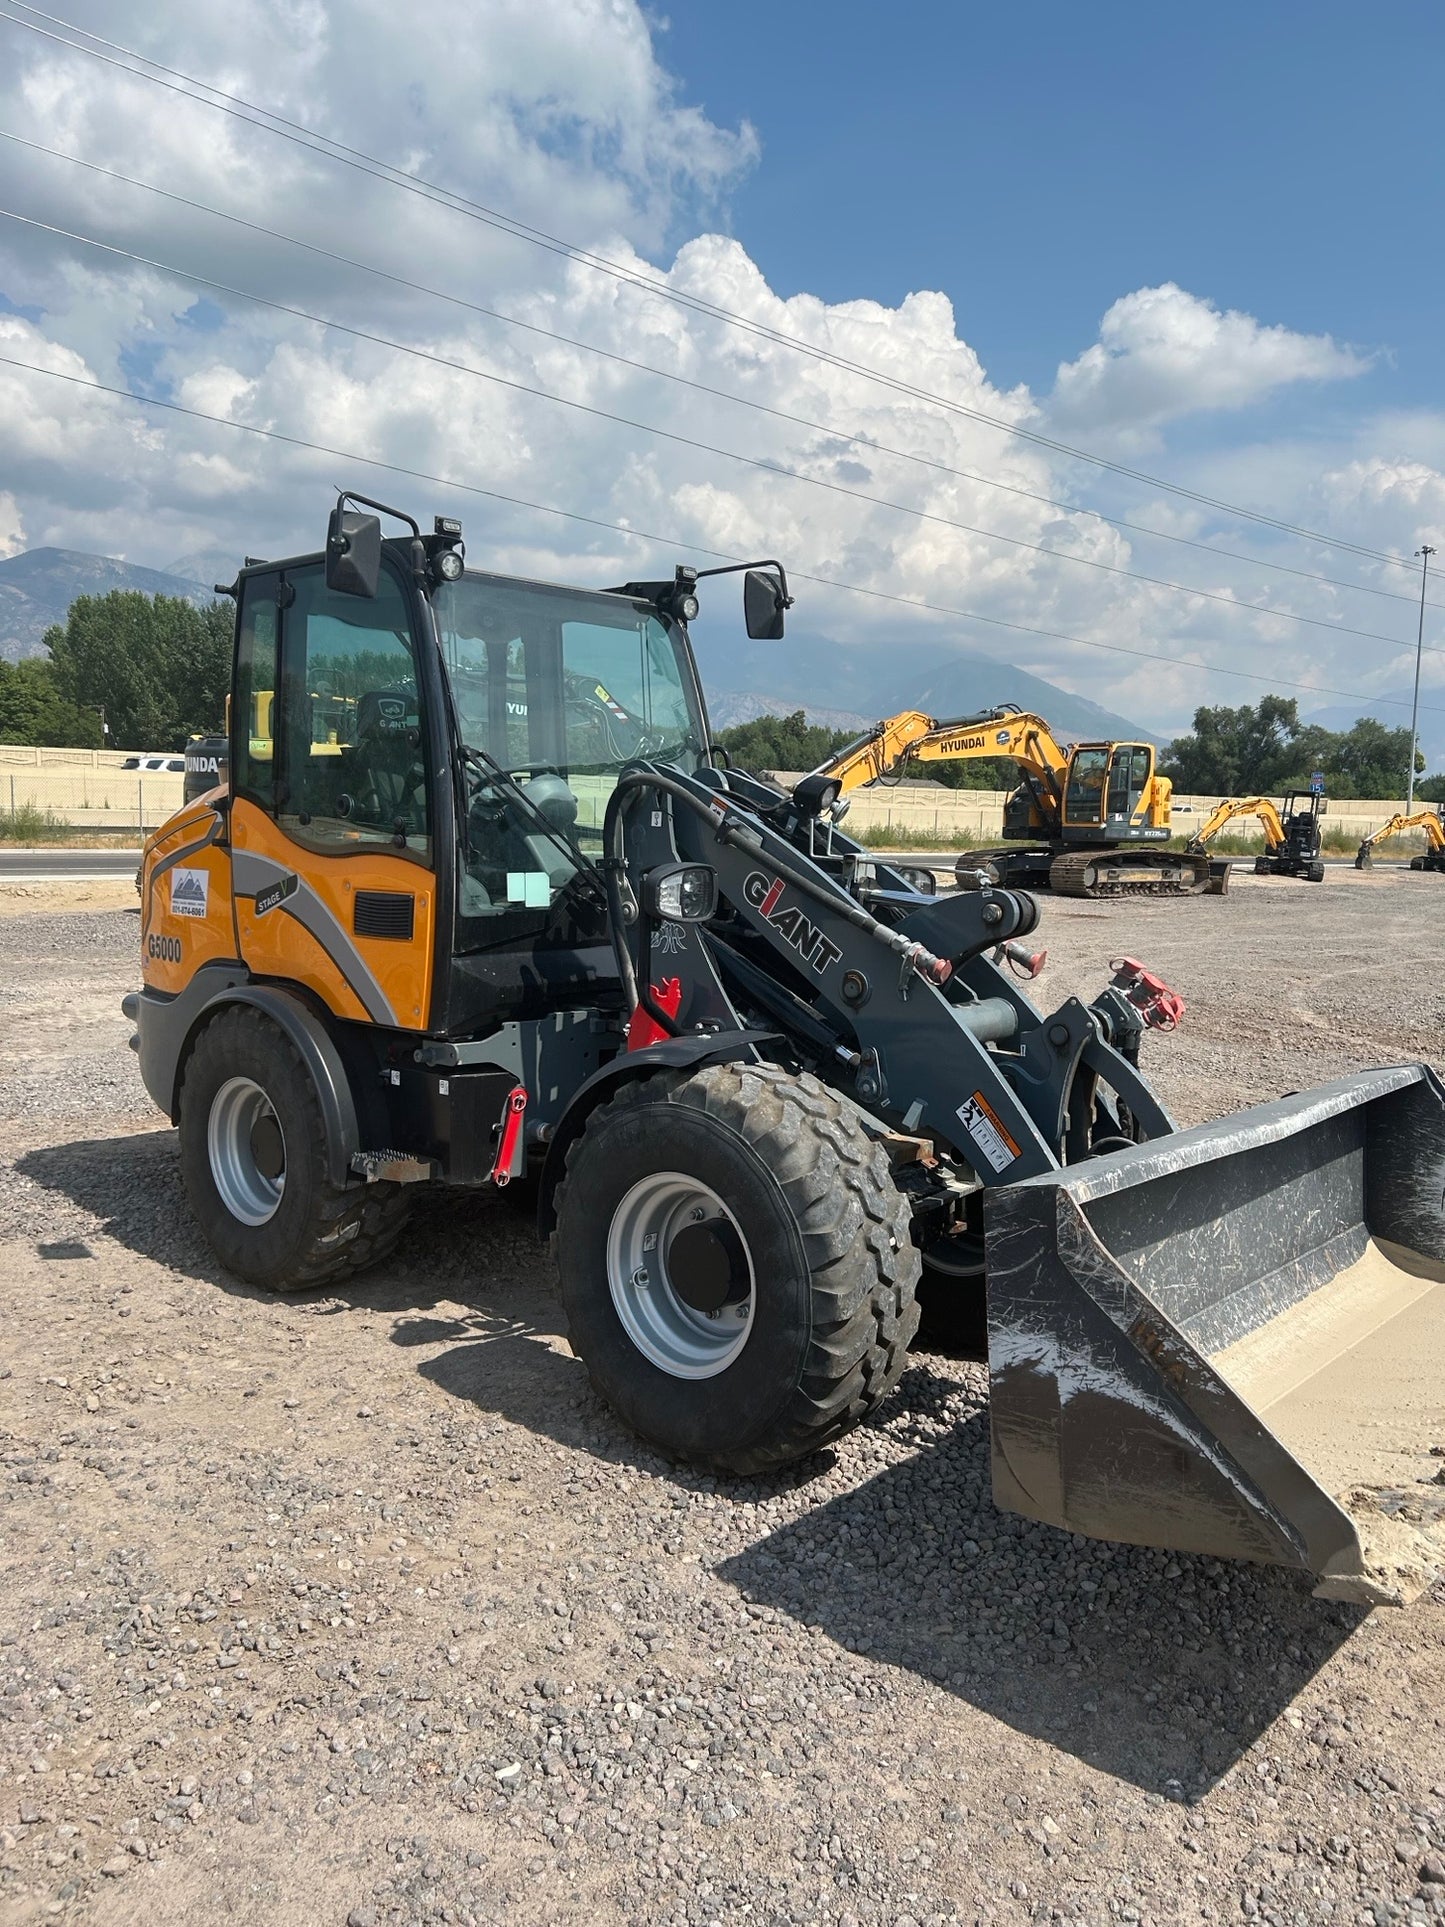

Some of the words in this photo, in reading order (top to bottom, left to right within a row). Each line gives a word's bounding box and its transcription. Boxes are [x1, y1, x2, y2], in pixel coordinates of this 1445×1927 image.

[940, 736, 985, 753] HYUNDAI
[1312, 783, 1321, 792] 15
[258, 891, 281, 911] STAGE
[148, 933, 181, 964] G5000
[988, 1112, 1009, 1141] WARNING
